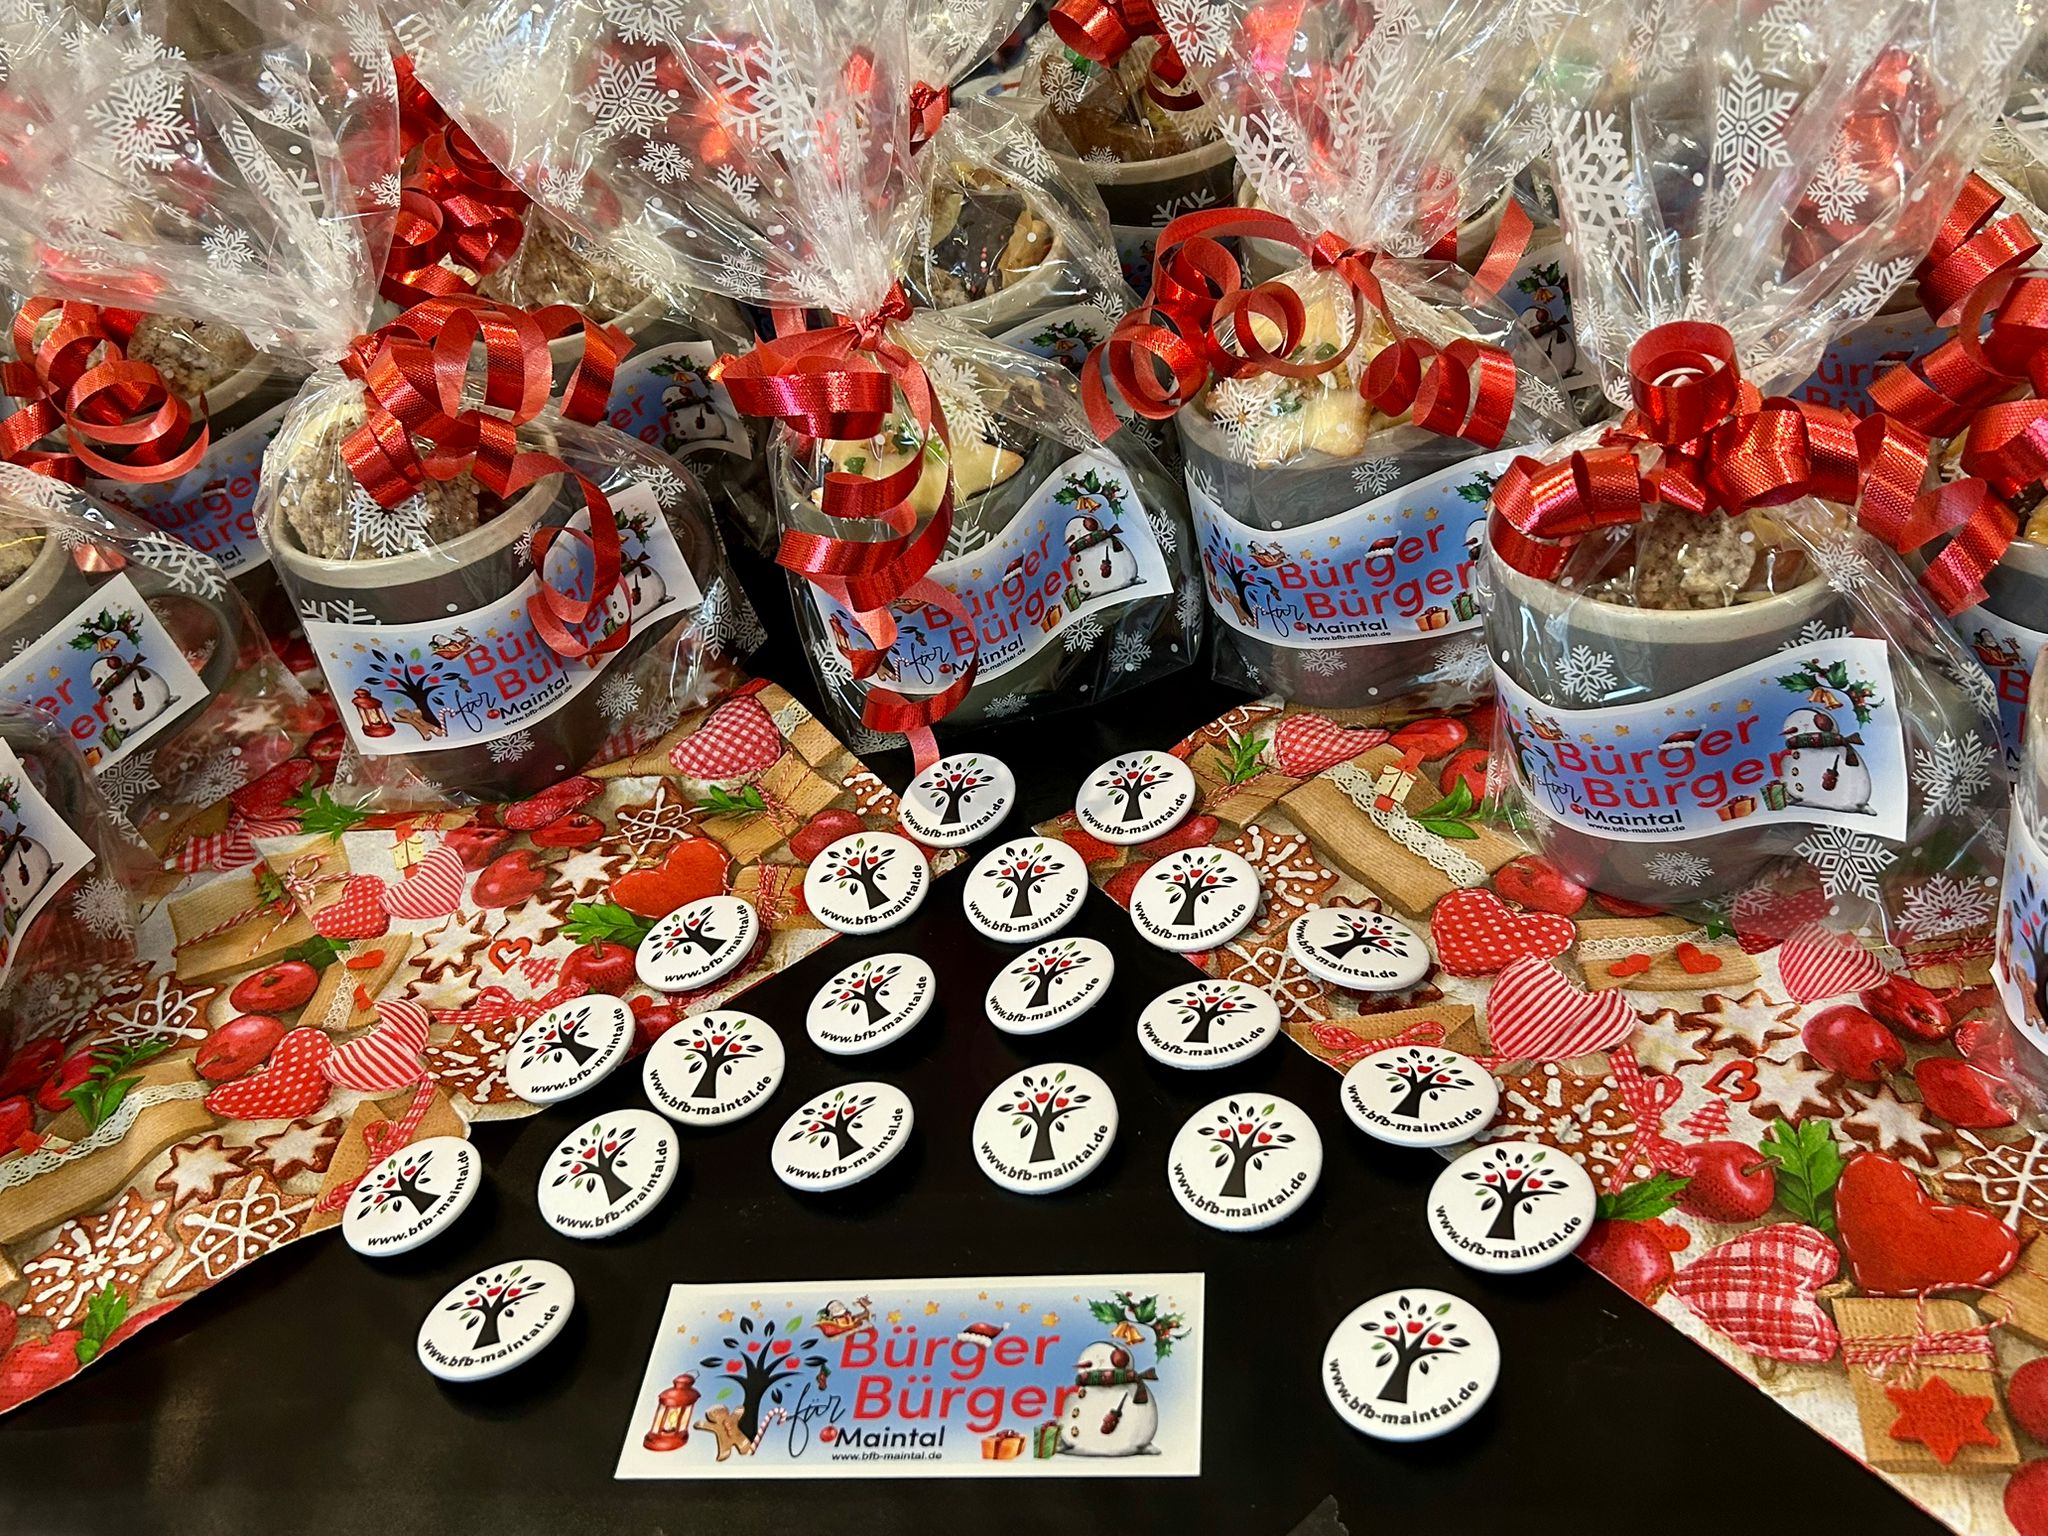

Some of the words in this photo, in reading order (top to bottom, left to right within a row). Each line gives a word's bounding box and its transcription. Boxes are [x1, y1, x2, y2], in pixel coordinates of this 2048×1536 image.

[1275, 524, 1446, 589] Bürger
[907, 643, 949, 684] für
[948, 554, 1077, 657] Bürger
[1265, 594, 1305, 638] für
[1303, 559, 1478, 619] Bürger
[1307, 617, 1389, 636] Maintal
[1310, 631, 1392, 642] www.bfb-maintal.de
[454, 690, 496, 734] für
[500, 671, 570, 720] Maintal
[504, 683, 574, 726] www.bfb-maintal.de
[1553, 715, 1760, 779] Bürger
[1540, 766, 1582, 815] für
[1582, 750, 1793, 808] Bürger
[903, 797, 1005, 838] www.bfb-maintal.de
[1081, 792, 1188, 835] www.bfb-maintal.de
[1583, 808, 1684, 827] Maintal
[1586, 820, 1686, 834] www.bfb-maintal.de
[820, 864, 923, 926] www.bfb-maintal.de
[967, 886, 1079, 933] www.bfb-maintal.de
[1134, 901, 1247, 942] www.bfb-maintal.de
[664, 904, 749, 983] www.bfb-maintal.de
[1295, 919, 1398, 980] www.bfb-maintal.de
[820, 975, 928, 1043] www.bfb-maintal.de
[990, 977, 1099, 1022] www.bfb-maintal.de
[531, 1007, 626, 1095] www.bfb-maintal.de
[1142, 1020, 1266, 1057] www.bfb-maintal.de
[650, 1069, 772, 1115] www.bfb-maintal.de
[1347, 1084, 1483, 1133] www.bfb-maintal.de
[785, 1107, 904, 1179] www.bfb-maintal.de
[980, 1123, 1109, 1181] www.bfb-maintal.de
[367, 1150, 469, 1247] www.bfb-maintal.de
[555, 1138, 668, 1230] www.bfb-maintal.de
[1173, 1162, 1308, 1218] www.bfb-maintal.de
[1435, 1203, 1583, 1260] www.bfb-maintal.de
[423, 1304, 560, 1368] www.bfb-maintal.de
[840, 1325, 1060, 1382] Bürger
[788, 1382, 846, 1457] für
[853, 1375, 1080, 1434] Bürger
[1329, 1357, 1479, 1425] www.bfb-maintal.de
[831, 1450, 943, 1461] www.bfb-maintal.de
[834, 1425, 946, 1448] Maintal
